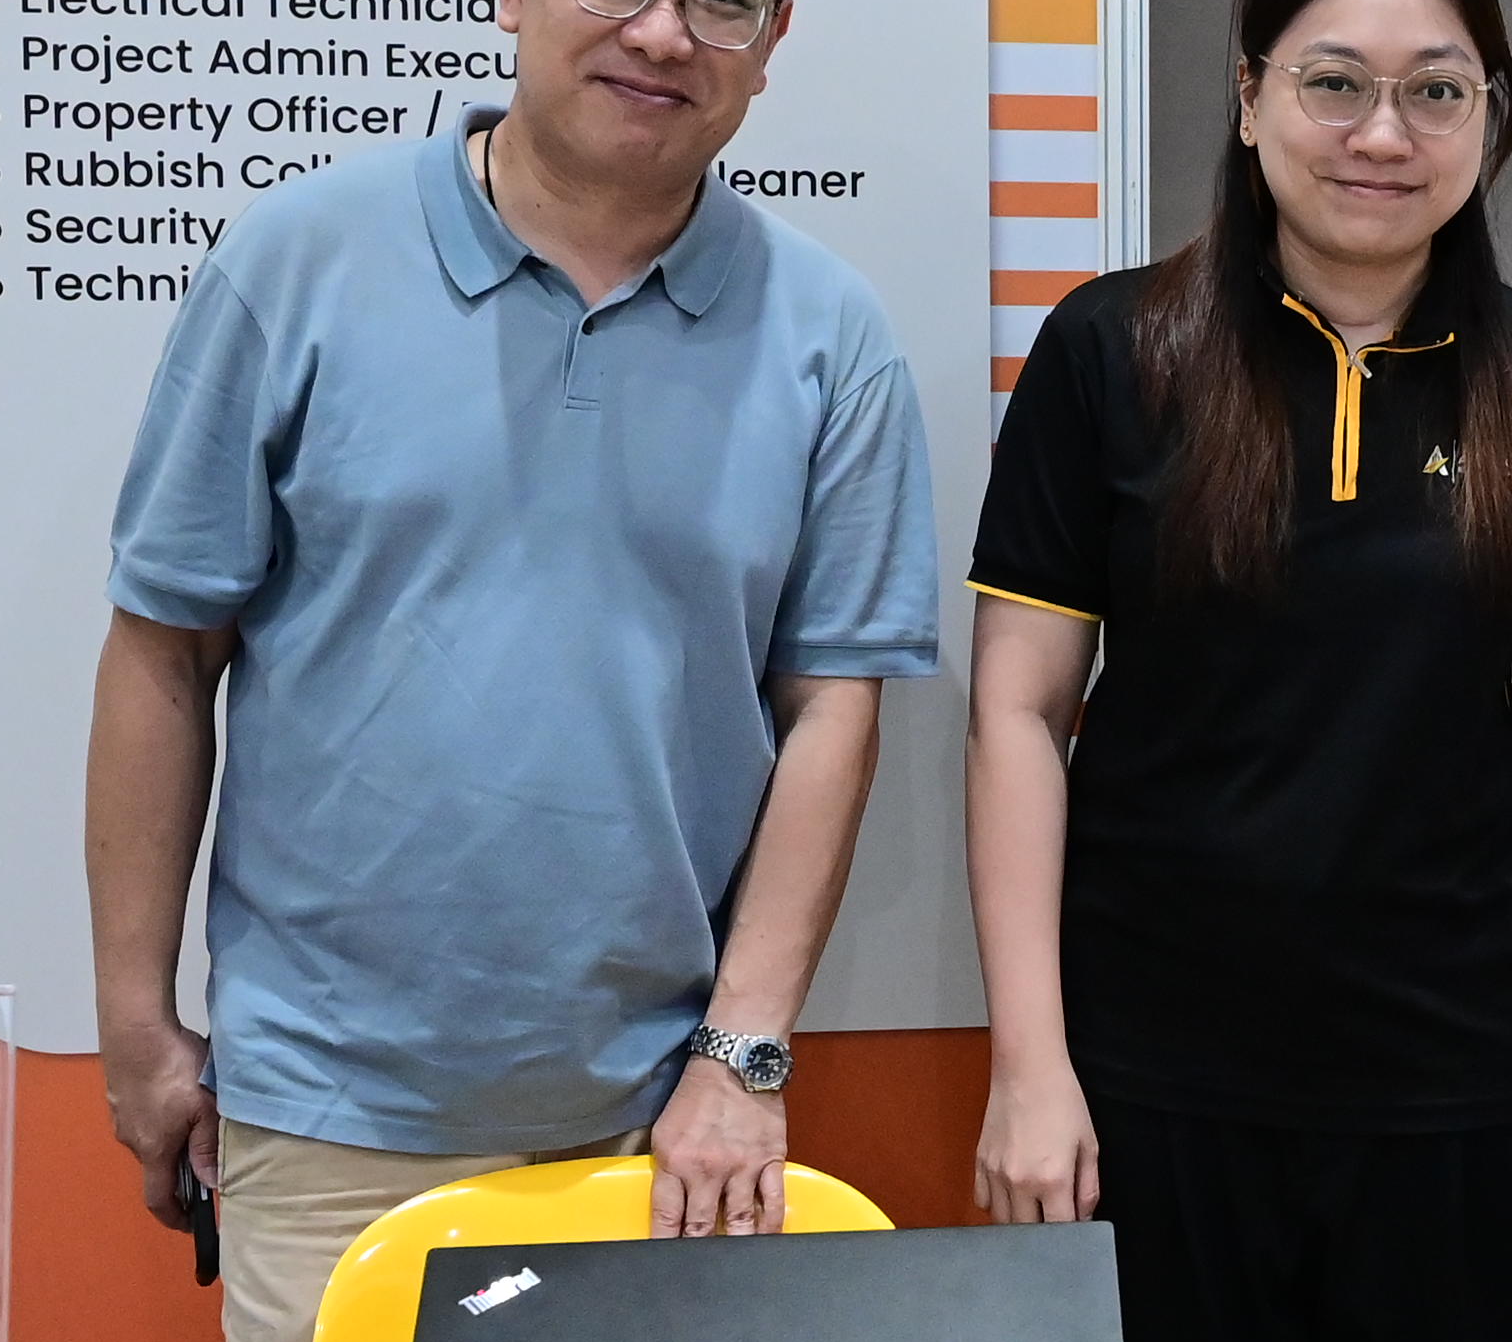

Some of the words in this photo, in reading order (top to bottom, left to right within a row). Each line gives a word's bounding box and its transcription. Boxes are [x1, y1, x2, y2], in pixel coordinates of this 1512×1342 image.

[21, 34, 193, 84] Project
[208, 39, 369, 77] Admin
[23, 93, 232, 143] Property
[247, 95, 408, 134] Officer
[425, 89, 443, 138] /
[24, 150, 224, 188] Rubbish
[25, 208, 226, 253] Security
